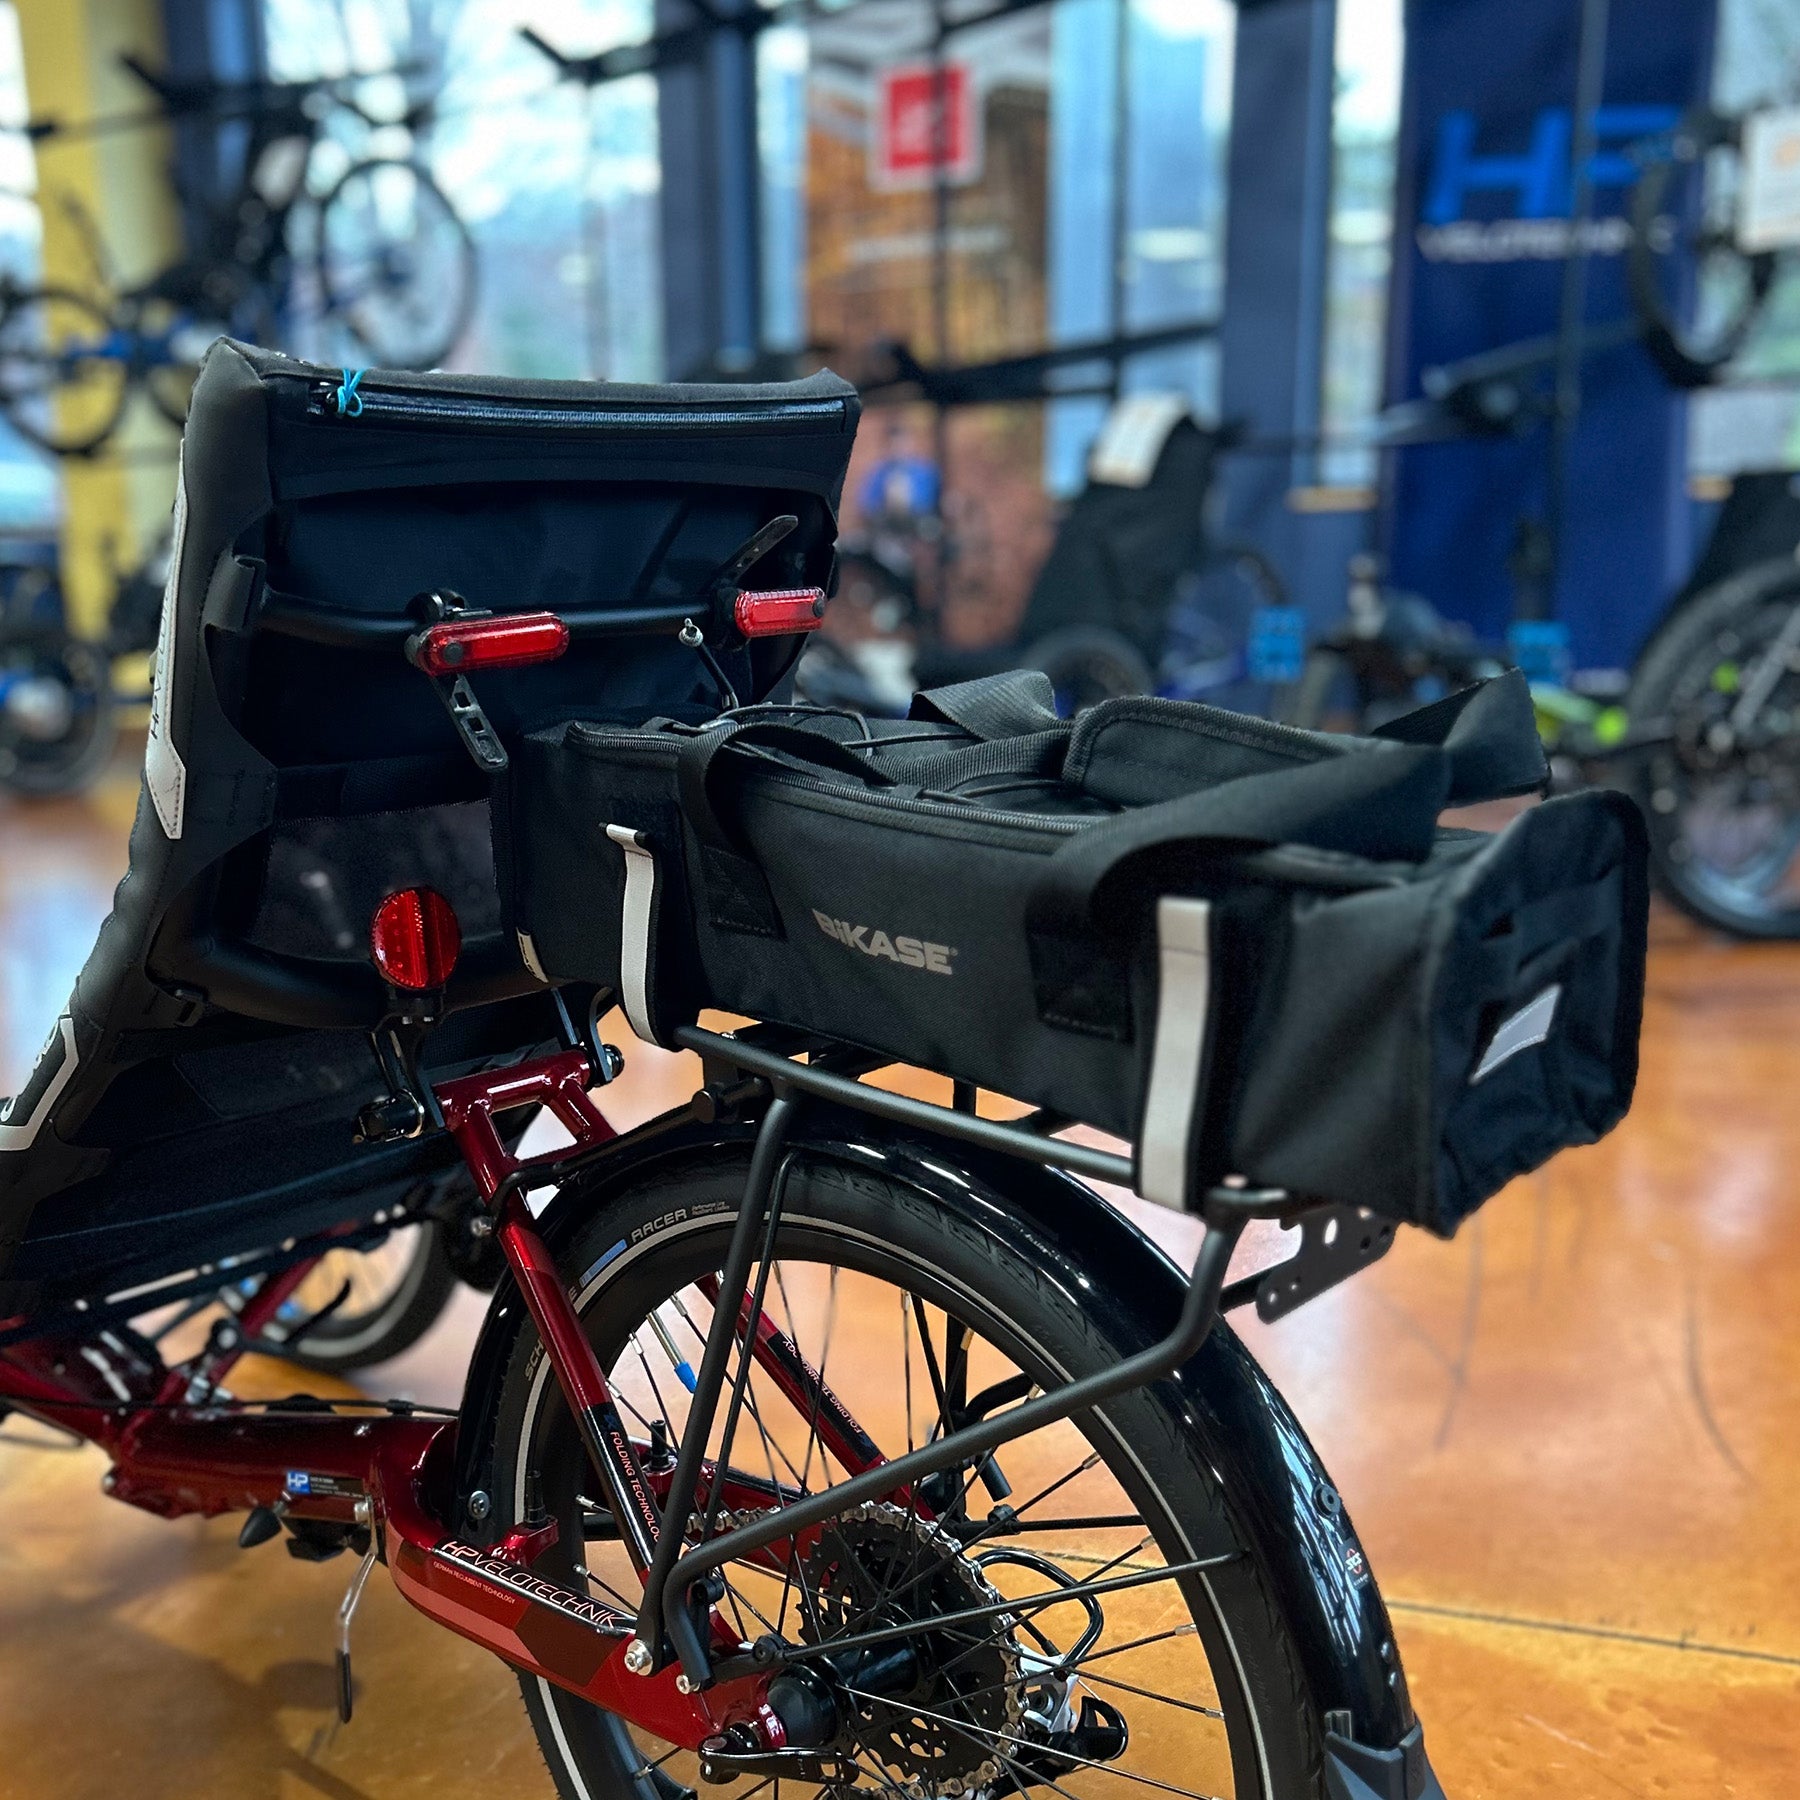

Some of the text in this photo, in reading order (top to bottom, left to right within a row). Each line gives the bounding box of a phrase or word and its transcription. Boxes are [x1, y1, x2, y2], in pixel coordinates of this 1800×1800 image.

[630, 1208, 688, 1243] RACER
[287, 1473, 308, 1488] HP
[610, 1431, 661, 1542] FOLDING TECHNOLO
